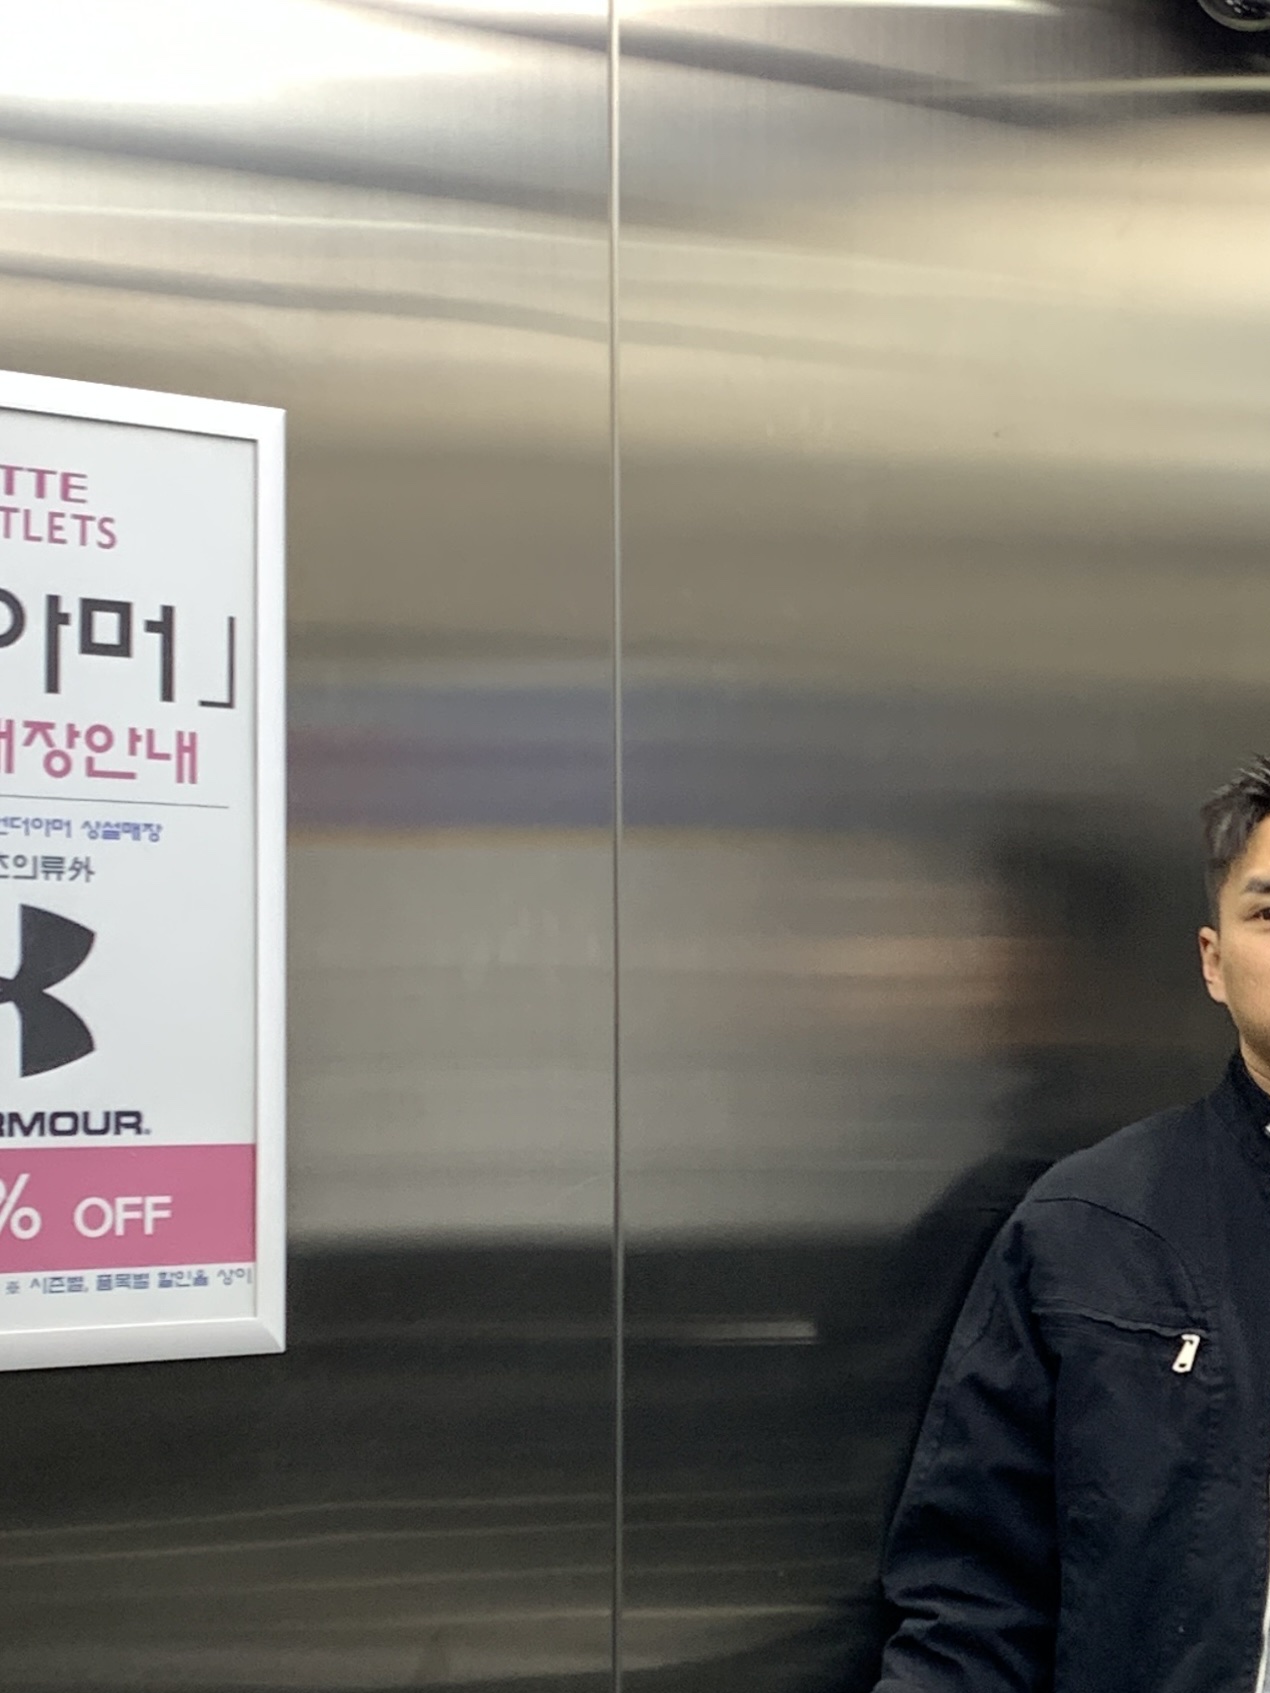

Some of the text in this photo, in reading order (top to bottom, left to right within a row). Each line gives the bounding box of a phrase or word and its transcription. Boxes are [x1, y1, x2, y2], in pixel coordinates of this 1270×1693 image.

[0, 506, 117, 549] TLETS
[81, 820, 163, 842] 상설매장
[73, 1195, 172, 1238] OFF
